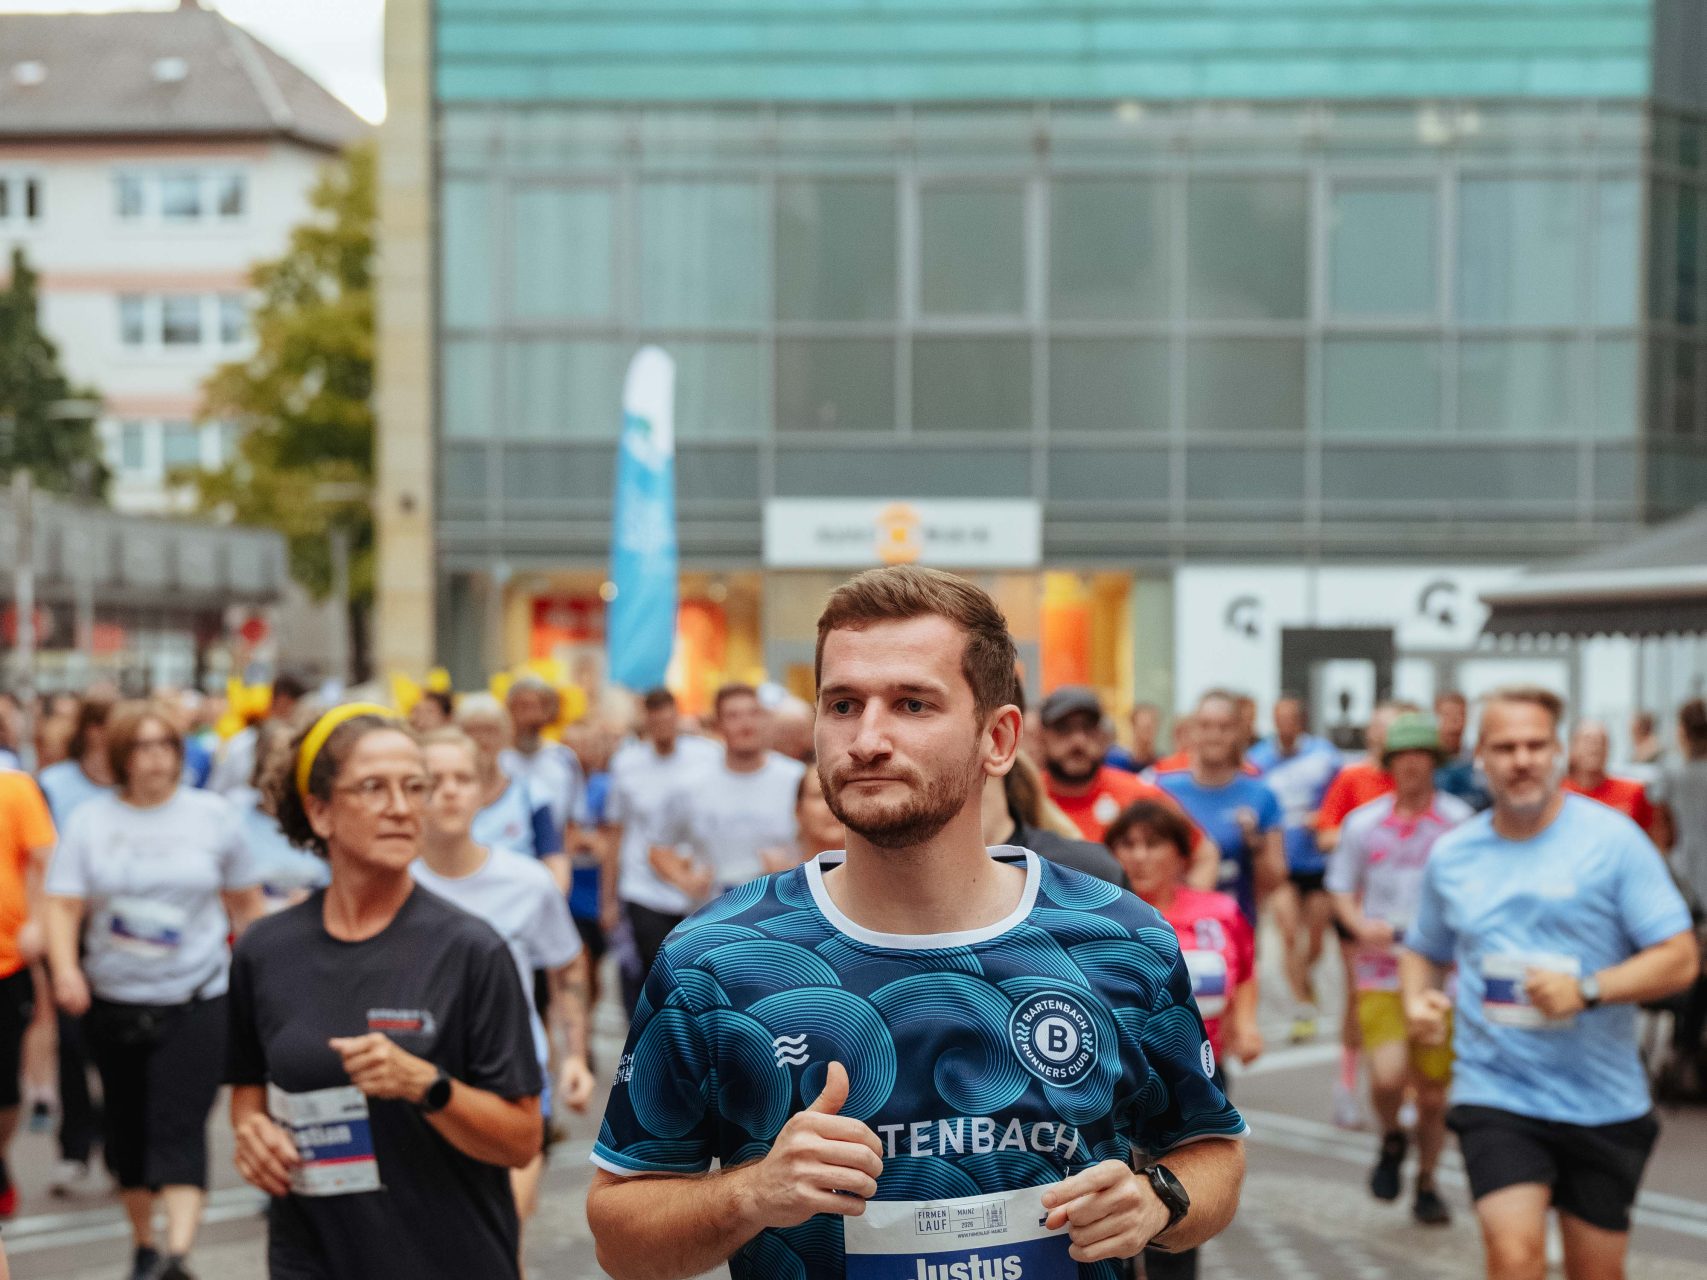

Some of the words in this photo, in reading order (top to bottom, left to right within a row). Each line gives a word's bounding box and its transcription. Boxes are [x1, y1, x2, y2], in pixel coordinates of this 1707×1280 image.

[1022, 999, 1089, 1030] BARTENBACH
[1048, 1024, 1068, 1053] B
[1021, 1043, 1067, 1078] RUNNERS
[1068, 1052, 1090, 1075] CLUB
[877, 1116, 1078, 1159] TENBACH
[918, 1209, 947, 1219] FIRMEN
[918, 1219, 947, 1232] LAUF
[957, 1207, 975, 1216] MAINZ
